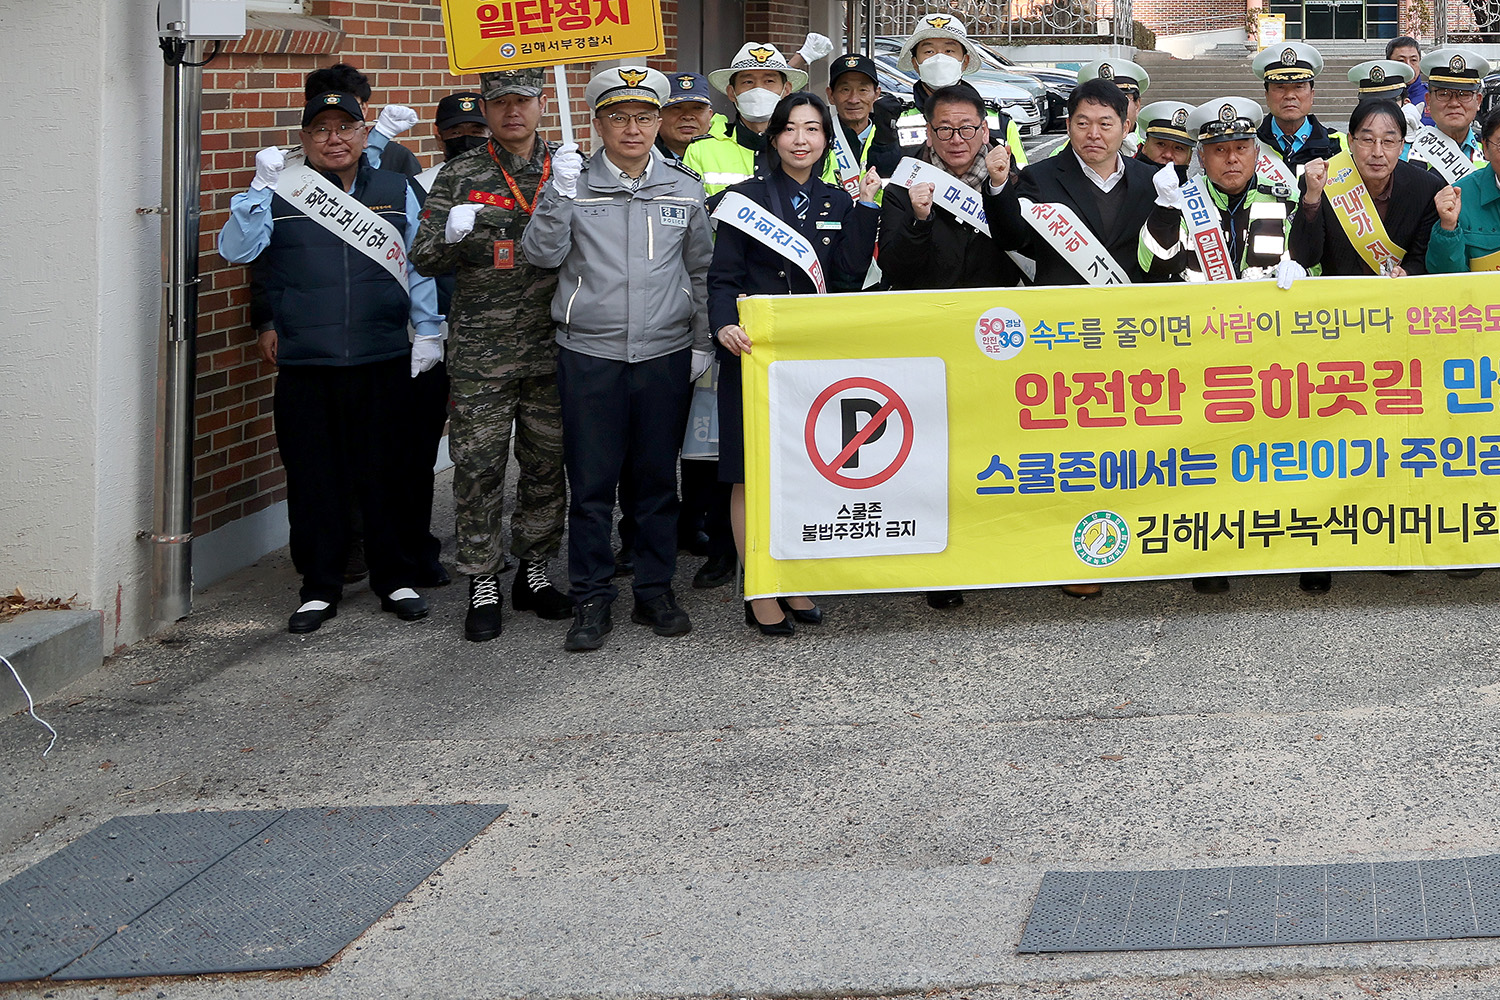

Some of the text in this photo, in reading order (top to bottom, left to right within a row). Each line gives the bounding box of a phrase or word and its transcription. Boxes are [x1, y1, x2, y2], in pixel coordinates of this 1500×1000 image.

[520, 35, 613, 55] 김해서부경찰서
[304, 186, 389, 250] 횡단보도앞
[663, 206, 684, 220] 경찰
[663, 218, 685, 226] POLICE
[737, 206, 809, 259] 우회전시
[1031, 203, 1089, 253] 천천히
[979, 318, 1005, 335] 50
[1005, 319, 1021, 328] 경남
[1030, 317, 1105, 350] 속도를
[1113, 315, 1192, 348] 줄이면
[1201, 309, 1281, 344] 사람이
[1290, 307, 1394, 340] 보입니다
[982, 336, 997, 345] 안전
[985, 345, 1000, 353] 속도
[998, 331, 1024, 348] 30
[1014, 366, 1187, 430] 안전한
[1202, 358, 1425, 424] 등하굣길
[840, 397, 887, 469] P
[975, 446, 1218, 496] 스쿨존에서는
[1230, 437, 1390, 484] 어린이가
[836, 502, 883, 521] 스쿨존
[801, 518, 917, 543] 불법주정차 금지
